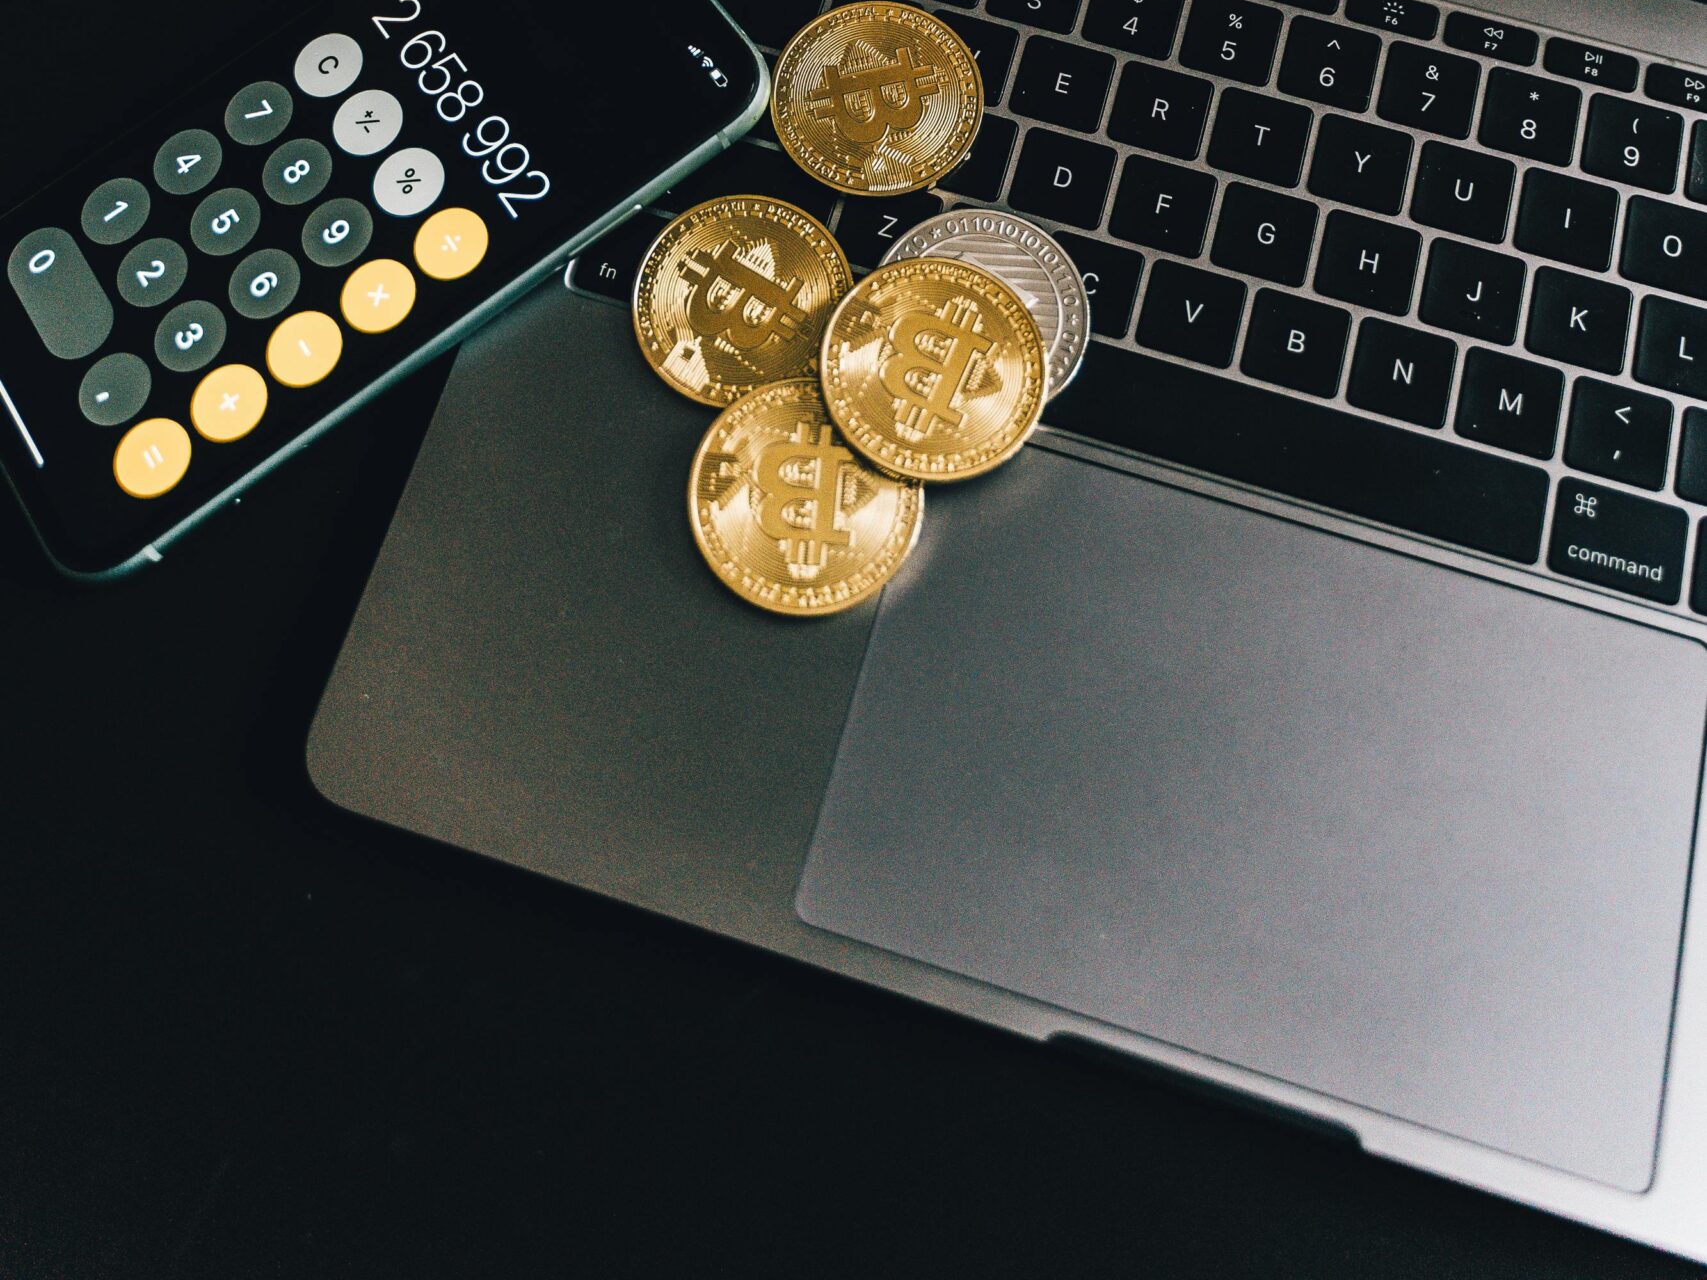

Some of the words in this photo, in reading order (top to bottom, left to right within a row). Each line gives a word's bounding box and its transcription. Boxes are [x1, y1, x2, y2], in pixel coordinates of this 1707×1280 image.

[1122, 16, 1138, 36] 4
[1228, 13, 1243, 30] %
[1385, 15, 1399, 26] F6
[1220, 40, 1237, 61] 5
[1484, 41, 1498, 52] F7
[318, 55, 339, 74] C
[1425, 64, 1439, 82] &
[1584, 66, 1599, 77] F8
[1054, 72, 1072, 94] E
[1318, 66, 1336, 88] 6
[245, 99, 274, 119] 7
[1151, 98, 1170, 121] R
[1420, 91, 1436, 112] 7
[1686, 92, 1701, 104] F9
[400, 30, 484, 122] 658
[462, 115, 550, 219] 992
[1254, 124, 1271, 146] T
[1520, 119, 1537, 140] 8
[176, 153, 202, 174] 4
[1353, 150, 1371, 174] Y
[1623, 146, 1641, 168] 9
[283, 159, 310, 184] 8
[396, 168, 422, 195] %
[1053, 166, 1073, 188] D
[1454, 178, 1475, 202] U
[103, 199, 129, 223] 1
[1155, 193, 1173, 214] F
[210, 207, 241, 235] 5
[877, 214, 898, 238] Z
[1564, 208, 1572, 229] I
[322, 219, 350, 245] 9
[1257, 222, 1277, 245] G
[1662, 234, 1683, 258] O
[28, 248, 56, 275] 0
[599, 262, 617, 280] fn
[1358, 249, 1380, 274] H
[136, 260, 166, 288] 2
[249, 271, 279, 298] 6
[1082, 272, 1100, 295] C
[1465, 281, 1483, 302] J
[1185, 299, 1204, 323] V
[1569, 306, 1589, 332] K
[174, 322, 204, 351] 3
[1286, 329, 1306, 353] B
[1678, 336, 1693, 361] L
[1392, 358, 1414, 385] N
[1498, 388, 1524, 416] M
[1567, 544, 1664, 582] command
